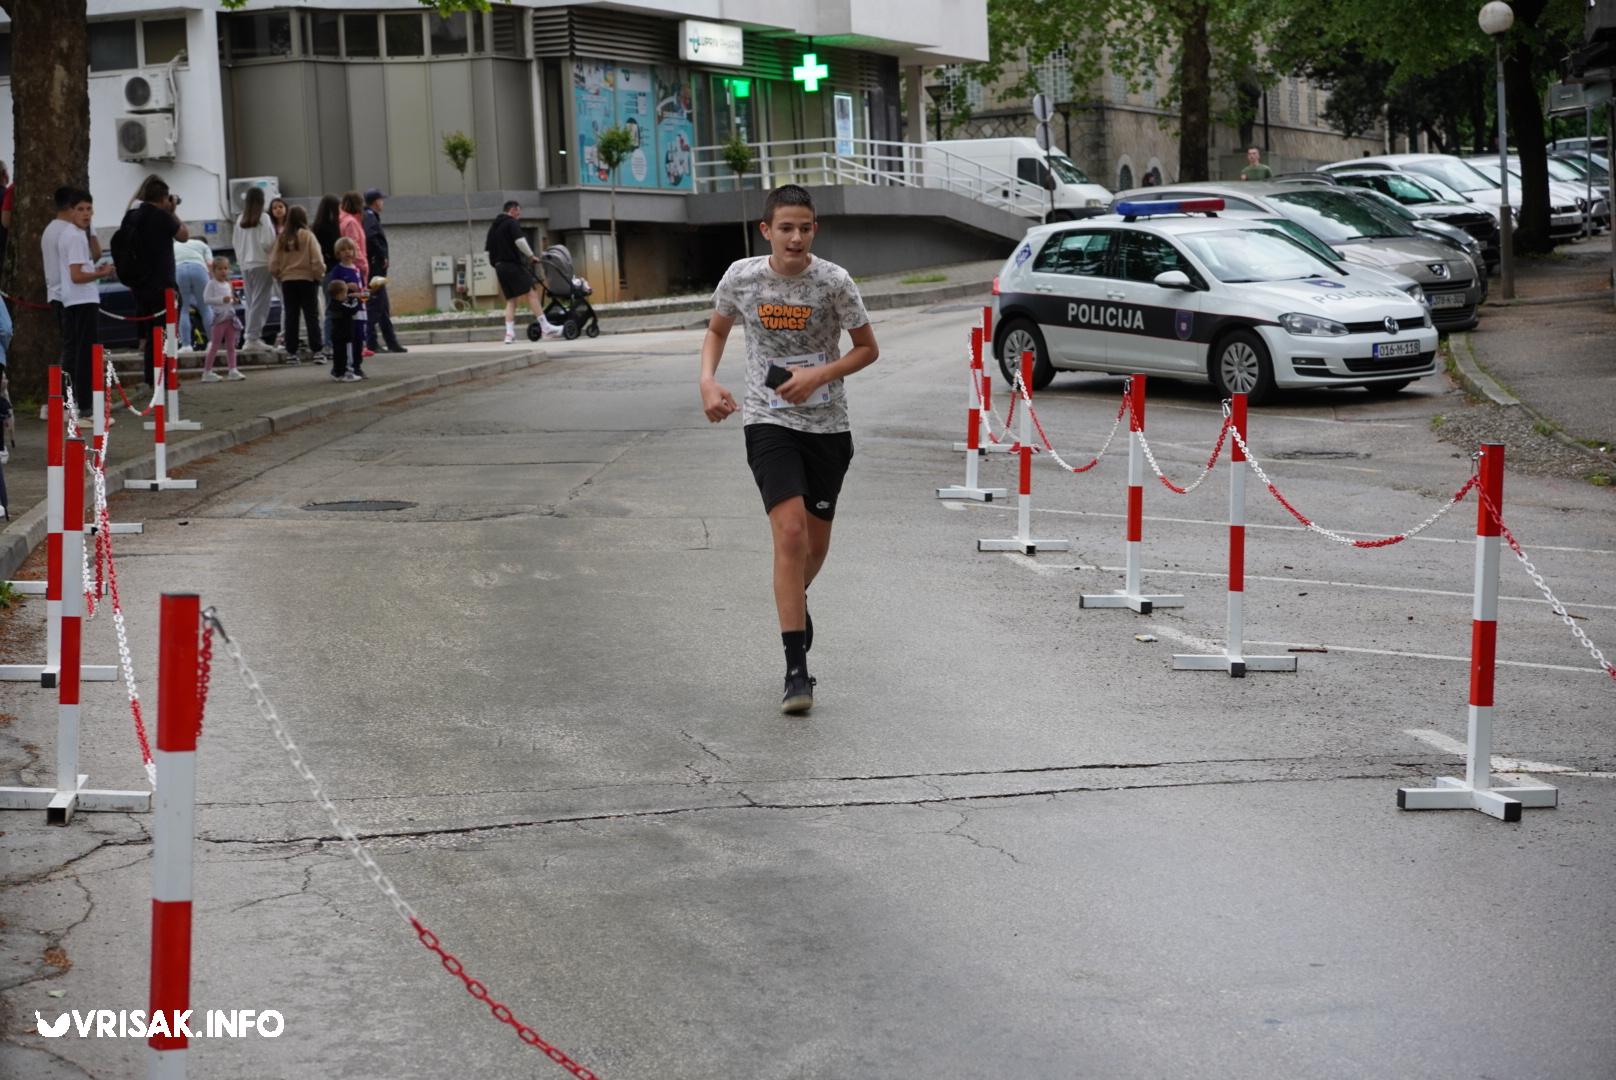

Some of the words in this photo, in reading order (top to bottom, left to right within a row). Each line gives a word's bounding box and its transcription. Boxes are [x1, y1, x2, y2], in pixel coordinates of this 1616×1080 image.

[1312, 289, 1404, 303] POLICIJA
[758, 304, 813, 318] LOONEY
[1068, 302, 1145, 330] POLICIJA
[761, 317, 806, 330] TUNES
